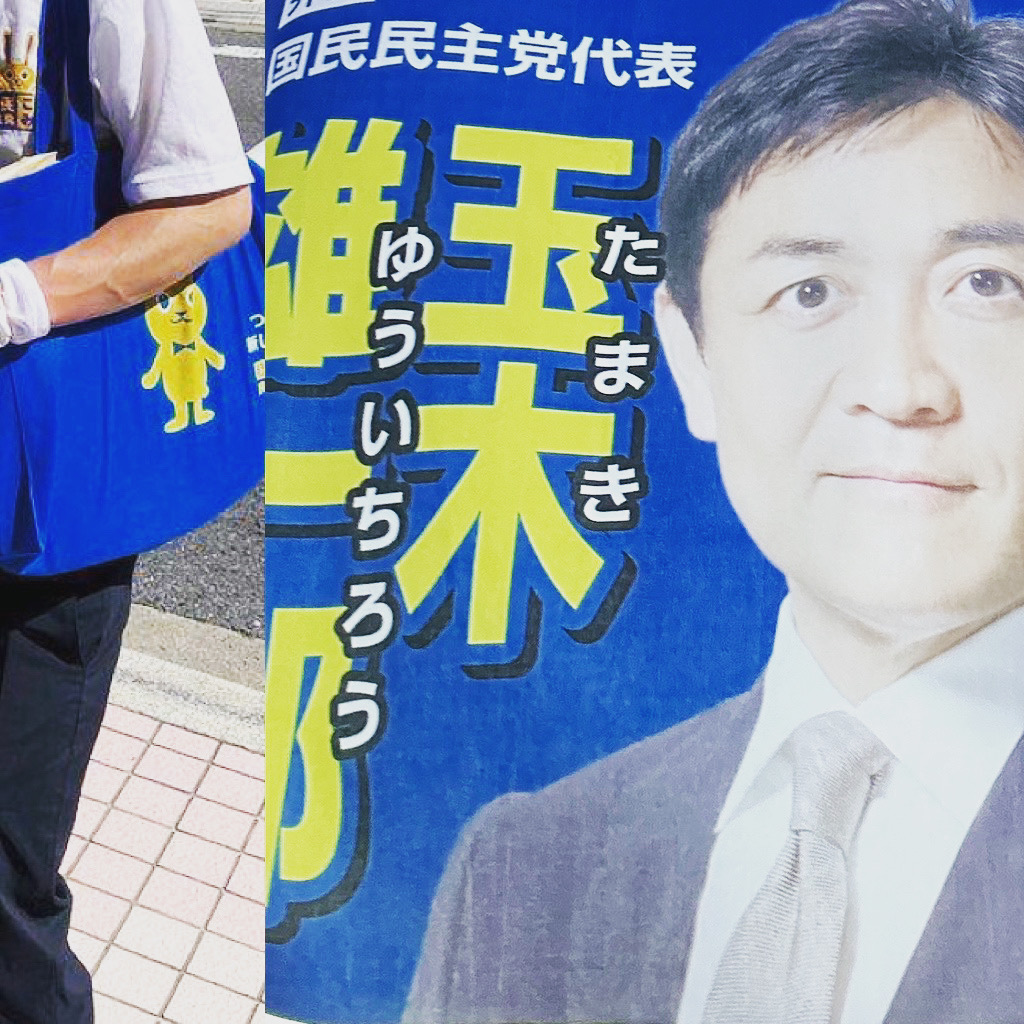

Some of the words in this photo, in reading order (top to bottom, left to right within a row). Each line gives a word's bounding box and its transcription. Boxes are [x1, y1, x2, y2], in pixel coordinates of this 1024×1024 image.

[265, 20, 697, 97] 国民民主党代表
[336, 225, 434, 751] ゆういちろう
[395, 125, 634, 646] 玉木
[579, 224, 660, 523] たまき
